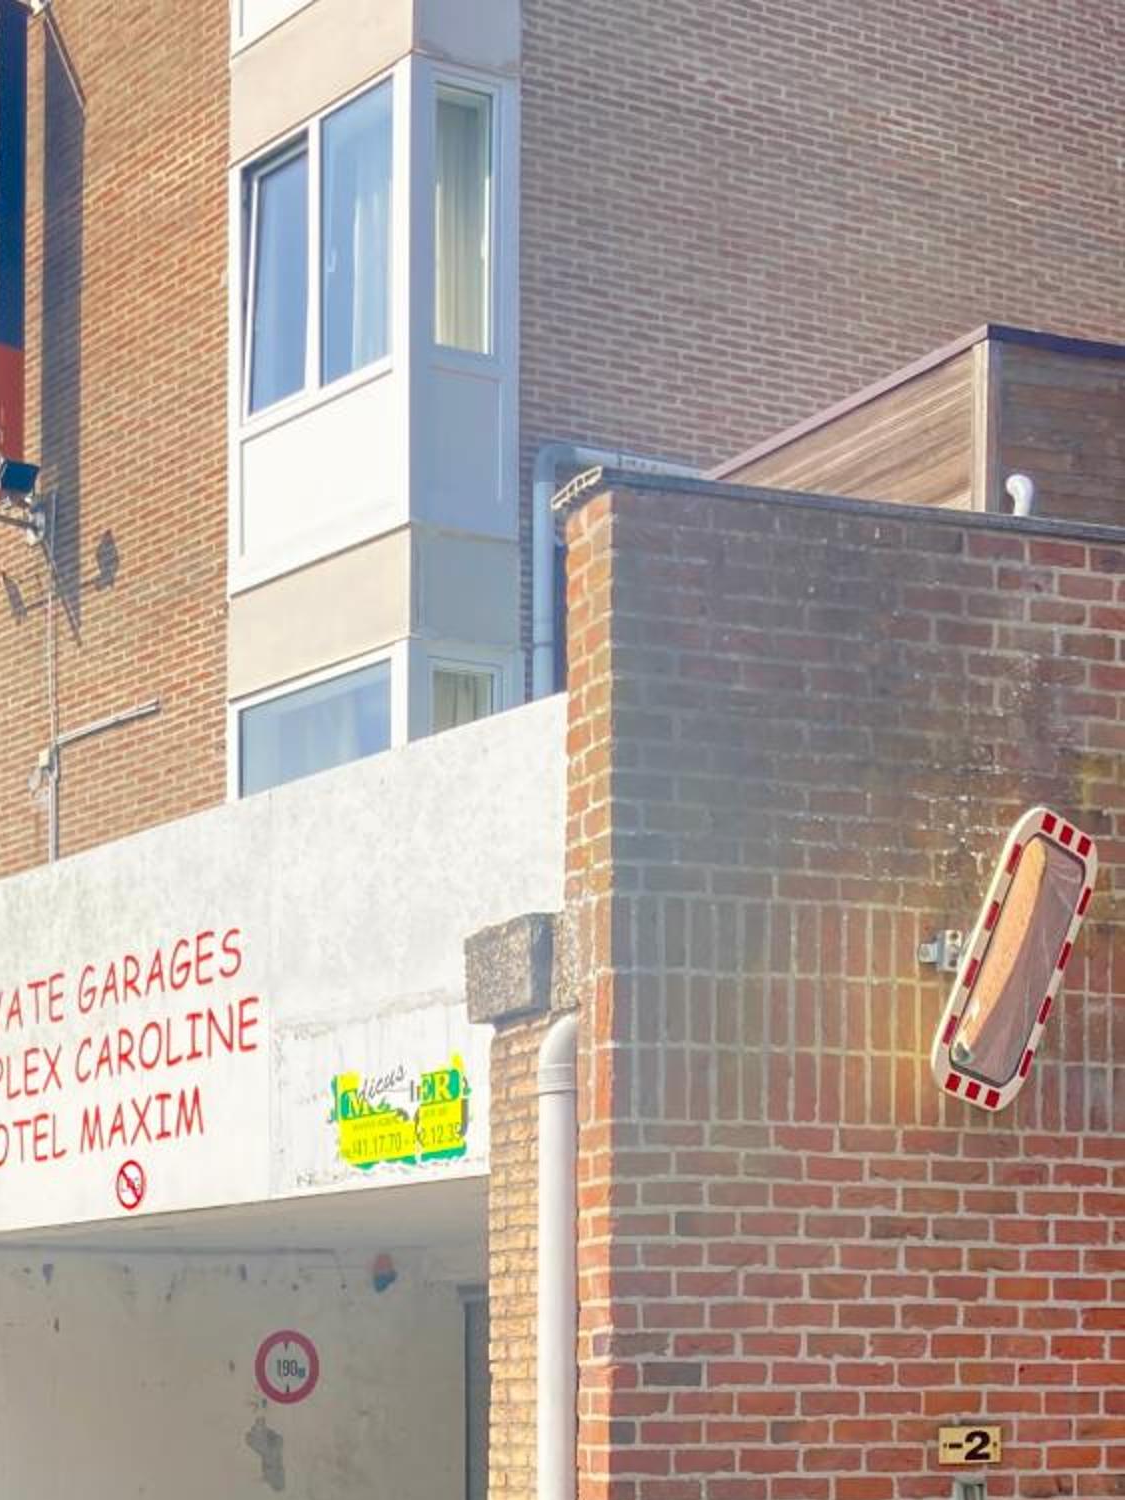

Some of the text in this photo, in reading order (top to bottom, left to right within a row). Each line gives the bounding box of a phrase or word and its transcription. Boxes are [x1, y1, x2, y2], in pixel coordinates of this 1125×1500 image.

[78, 928, 242, 1014] GARAGES
[75, 996, 260, 1083] CAROLINE
[79, 1085, 205, 1154] MAXIM
